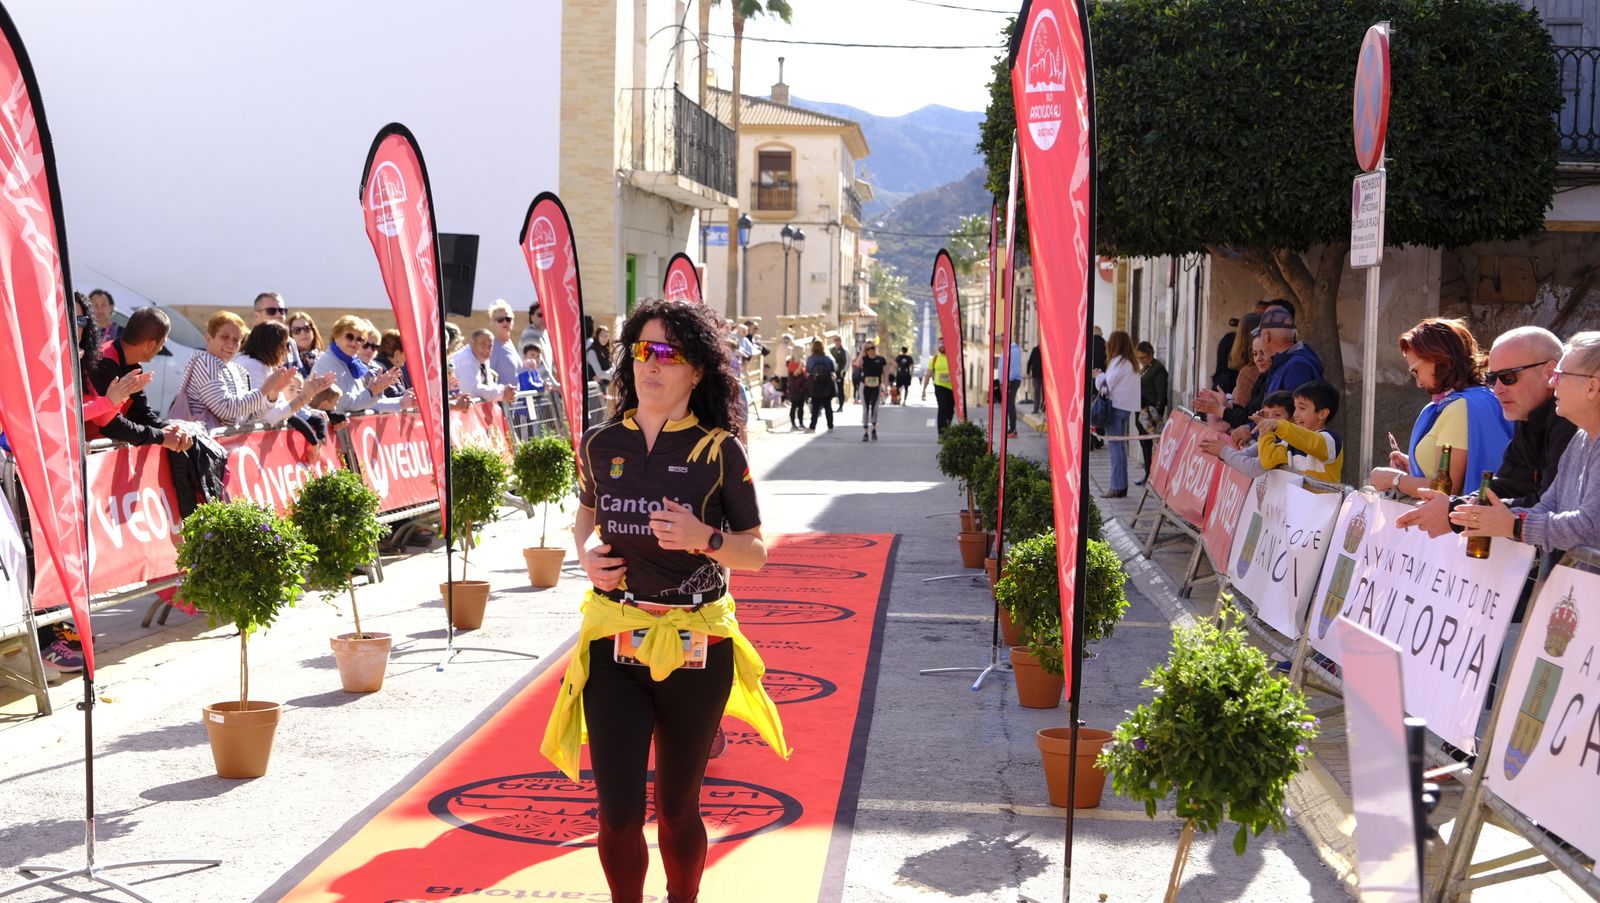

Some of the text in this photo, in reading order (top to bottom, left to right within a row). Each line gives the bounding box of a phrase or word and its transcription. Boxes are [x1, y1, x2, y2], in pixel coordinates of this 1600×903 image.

[96, 486, 183, 549] VEOL
[607, 520, 655, 536] Runn
[1481, 588, 1501, 620] DE
[708, 790, 760, 799] LA
